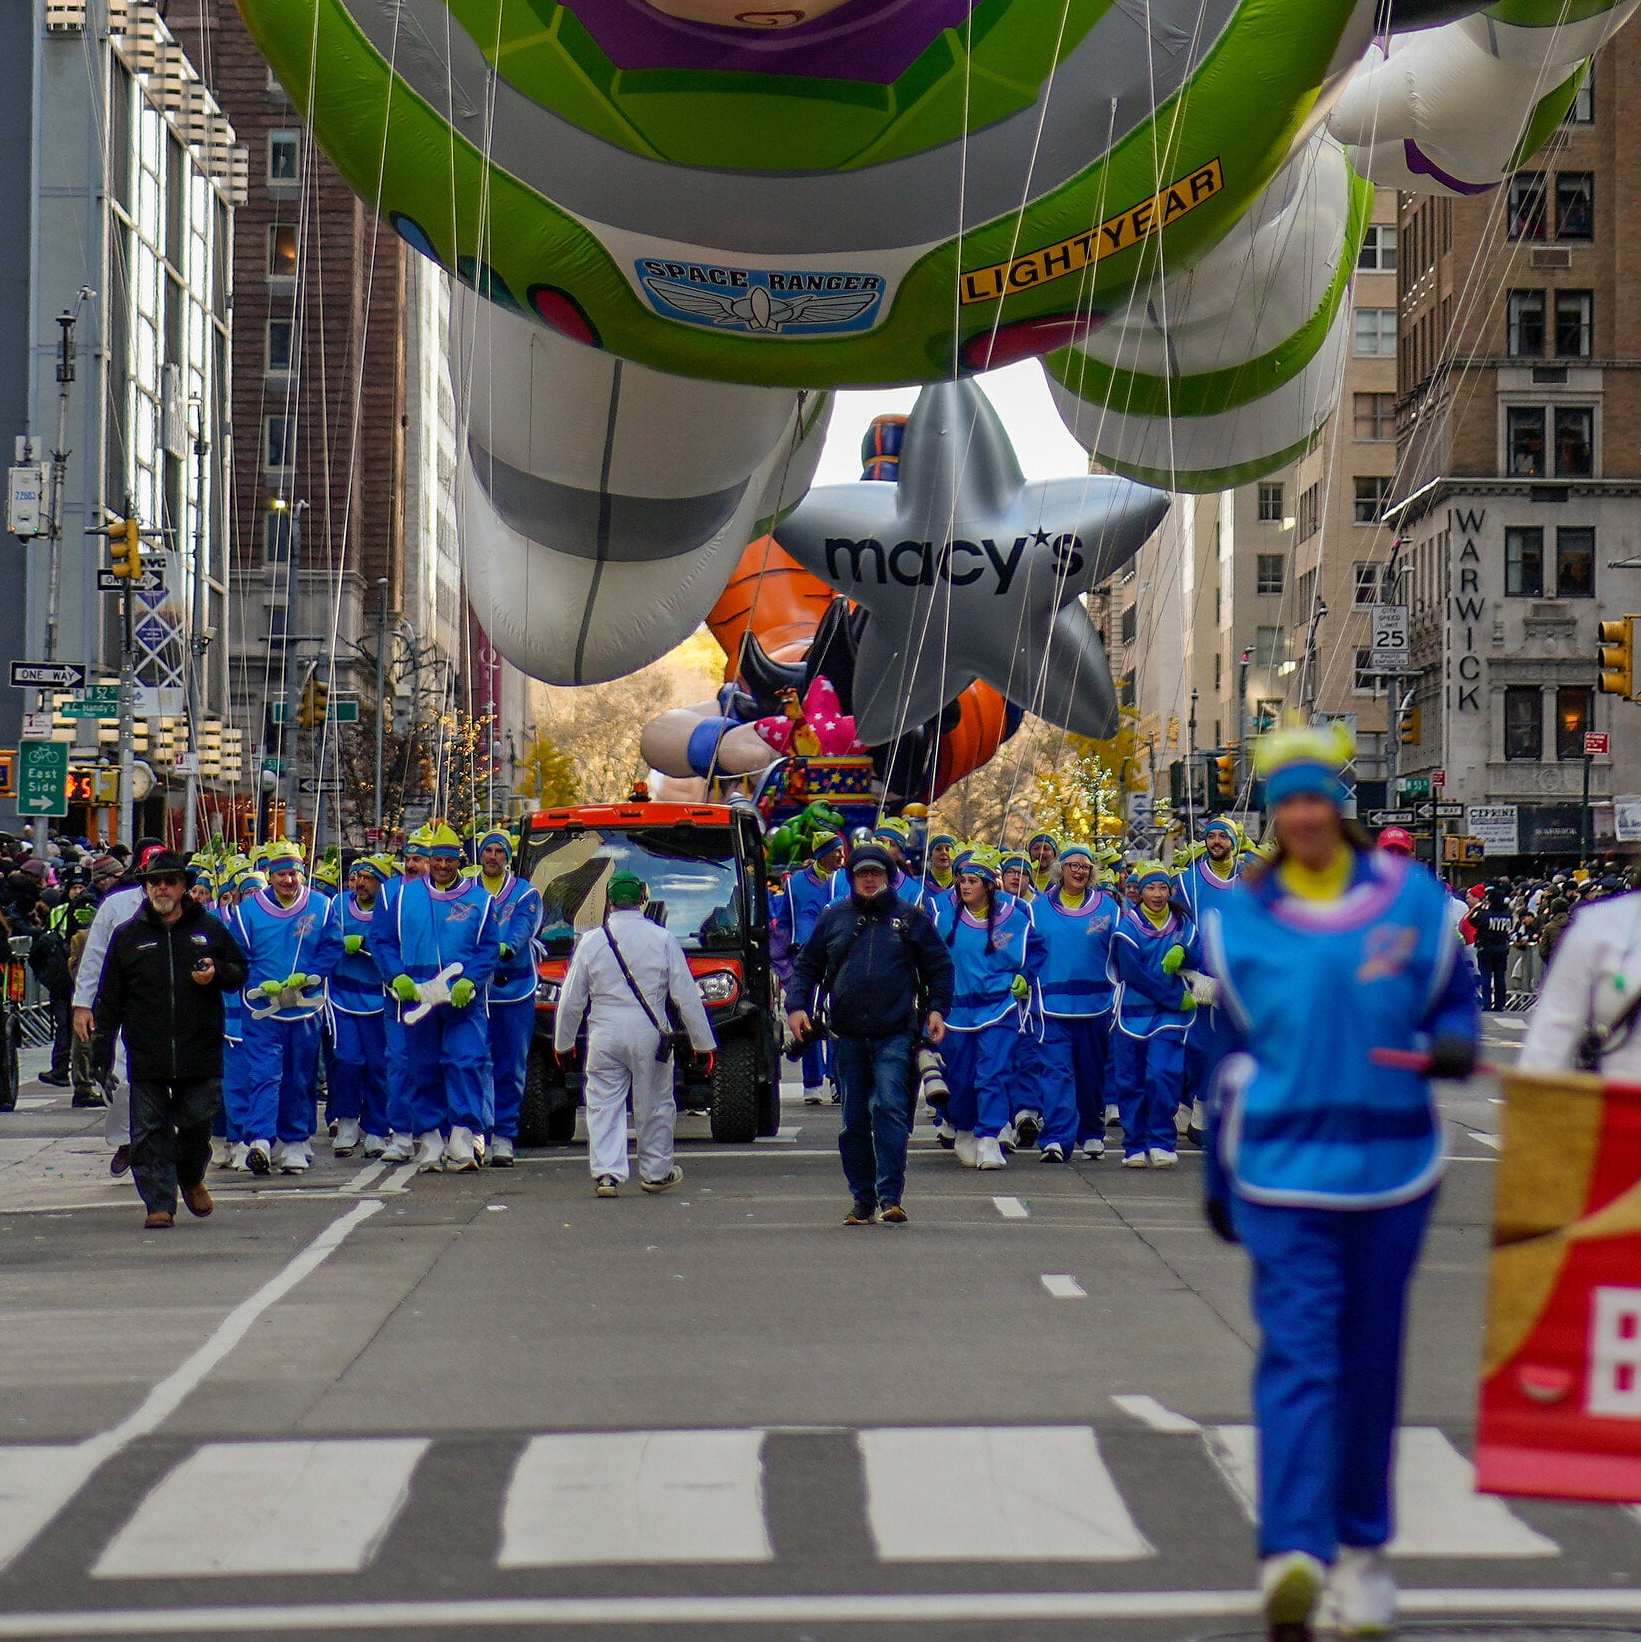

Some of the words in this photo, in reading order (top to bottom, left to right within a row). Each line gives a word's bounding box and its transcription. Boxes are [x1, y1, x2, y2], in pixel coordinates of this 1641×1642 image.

[966, 167, 1215, 299] LIGHTYEAR
[644, 260, 748, 288] SPACE
[768, 272, 880, 291] RANGER
[824, 526, 1084, 595] macy's
[1455, 509, 1486, 711] WARWICK
[1376, 630, 1404, 647] 25
[22, 670, 42, 679] ONE
[53, 671, 74, 681] WAY
[86, 687, 94, 698] W
[97, 687, 108, 699] 52
[82, 703, 115, 713] Handy's
[28, 768, 57, 779] East
[28, 782, 57, 792] Side
[81, 777, 92, 798] 5
[1414, 780, 1423, 790] 53
[1488, 917, 1511, 932] NYPD
